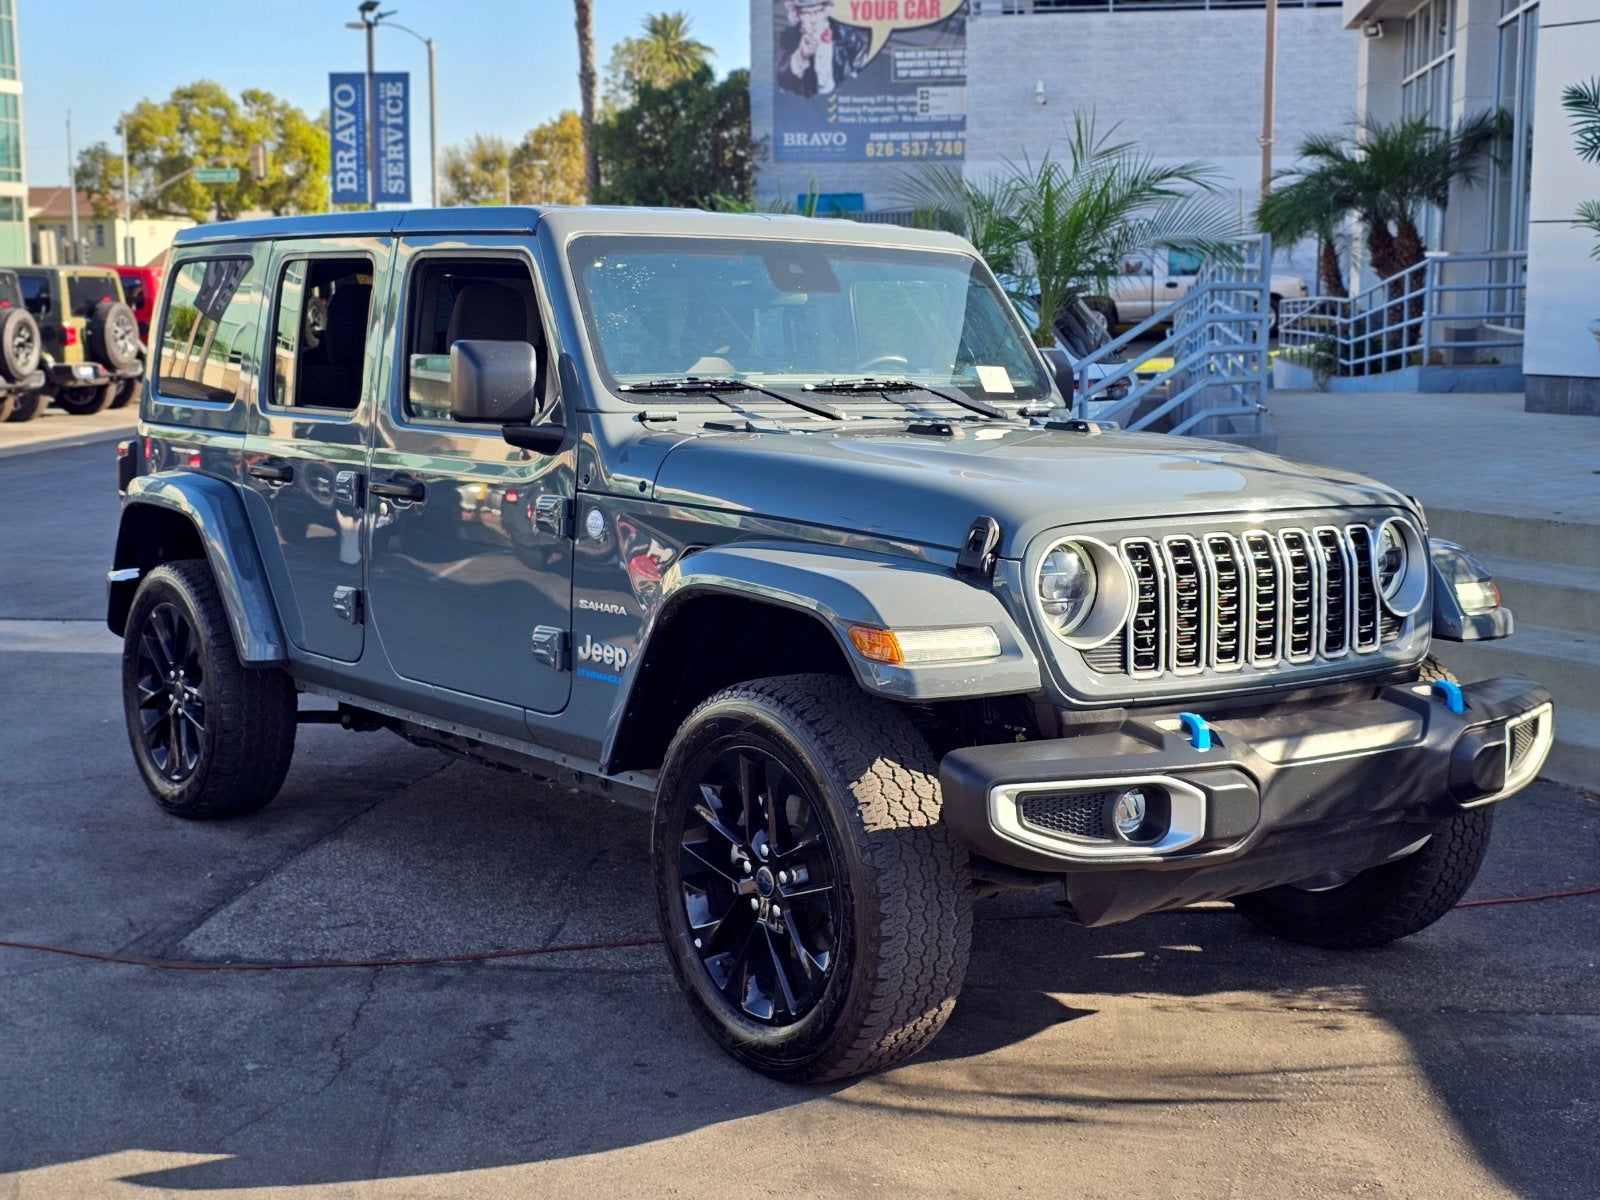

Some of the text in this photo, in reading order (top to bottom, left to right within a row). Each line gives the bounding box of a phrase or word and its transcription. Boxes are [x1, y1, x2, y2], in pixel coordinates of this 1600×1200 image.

[849, 0, 941, 21] YOUR CAR
[333, 83, 358, 193] BRAVO
[385, 81, 405, 194] SERVICE
[783, 132, 847, 146] BRAVO
[579, 599, 628, 616] SAHARA
[577, 633, 629, 672] Jeep
